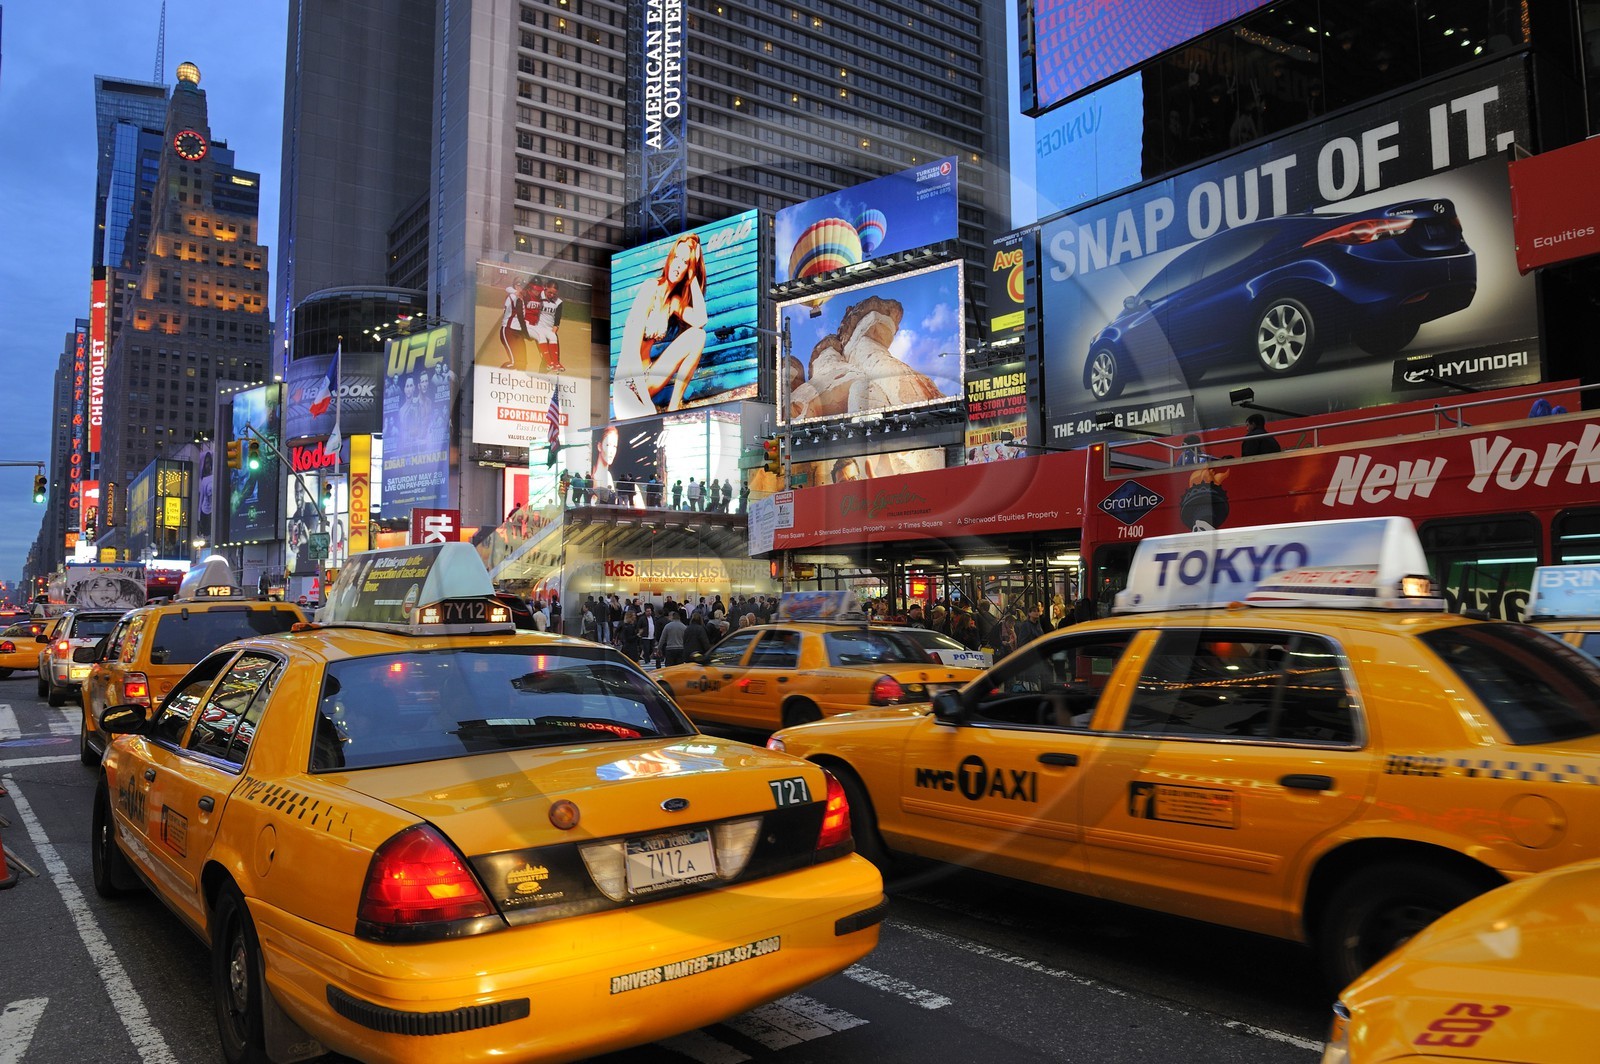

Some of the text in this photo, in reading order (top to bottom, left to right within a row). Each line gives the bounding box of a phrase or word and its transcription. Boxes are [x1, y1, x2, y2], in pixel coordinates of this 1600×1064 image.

[645, 30, 663, 150] AMERICAN
[915, 166, 940, 177] TURKISH
[915, 171, 940, 183] AIRLINES
[1049, 85, 1515, 282] SNAP OUT OF IT.
[1533, 225, 1596, 249] Equities
[386, 327, 448, 378] UFC
[73, 332, 87, 401] ERNST
[1438, 350, 1529, 378] HYUNDAI
[91, 339, 105, 426] CHEVROLET
[489, 371, 534, 390] Helped
[967, 372, 1027, 394] THE MUSI
[490, 390, 575, 408] opponent in.
[967, 392, 985, 403] YOU
[968, 402, 982, 413] THE
[983, 398, 1006, 411] STORY
[968, 409, 997, 421] NEVER
[1053, 423, 1074, 439] THE
[1126, 402, 1186, 427] ELANTRA
[516, 423, 530, 431] Pass
[69, 438, 82, 510] YOUNG
[383, 458, 406, 471] EDGAR
[1322, 424, 1600, 508] New York
[384, 484, 397, 493] LIVE
[405, 477, 446, 490] PAY-PER-VIEW
[387, 473, 418, 486] SATURDAY
[418, 472, 433, 481] MAY
[351, 472, 368, 537] Kodak
[868, 483, 927, 519] Garden
[1103, 493, 1159, 510] Gray Line
[790, 532, 805, 540] Square
[818, 528, 842, 537] Sherwood
[842, 526, 862, 534] Equities
[863, 524, 886, 533] Property
[898, 522, 902, 530] 2
[903, 521, 921, 529] Times
[921, 519, 943, 529] Square
[956, 516, 963, 525] A
[963, 514, 996, 525] Sherwood
[997, 513, 1026, 524] Equities
[1026, 509, 1059, 520] Property
[1076, 507, 1082, 516] 2
[1117, 524, 1144, 539] 71400
[603, 559, 635, 577] tkts
[1153, 541, 1308, 587] TOKYO
[660, 576, 699, 584] Development
[207, 586, 232, 596] 1Y23
[443, 602, 485, 619] 7Y12
[953, 653, 985, 662] POLICE
[235, 776, 268, 801] 7Y12
[915, 754, 1038, 803] NYC TAXI
[771, 777, 809, 806] 727
[507, 873, 549, 884] MANHATTAN
[611, 966, 662, 994] DRIVERS
